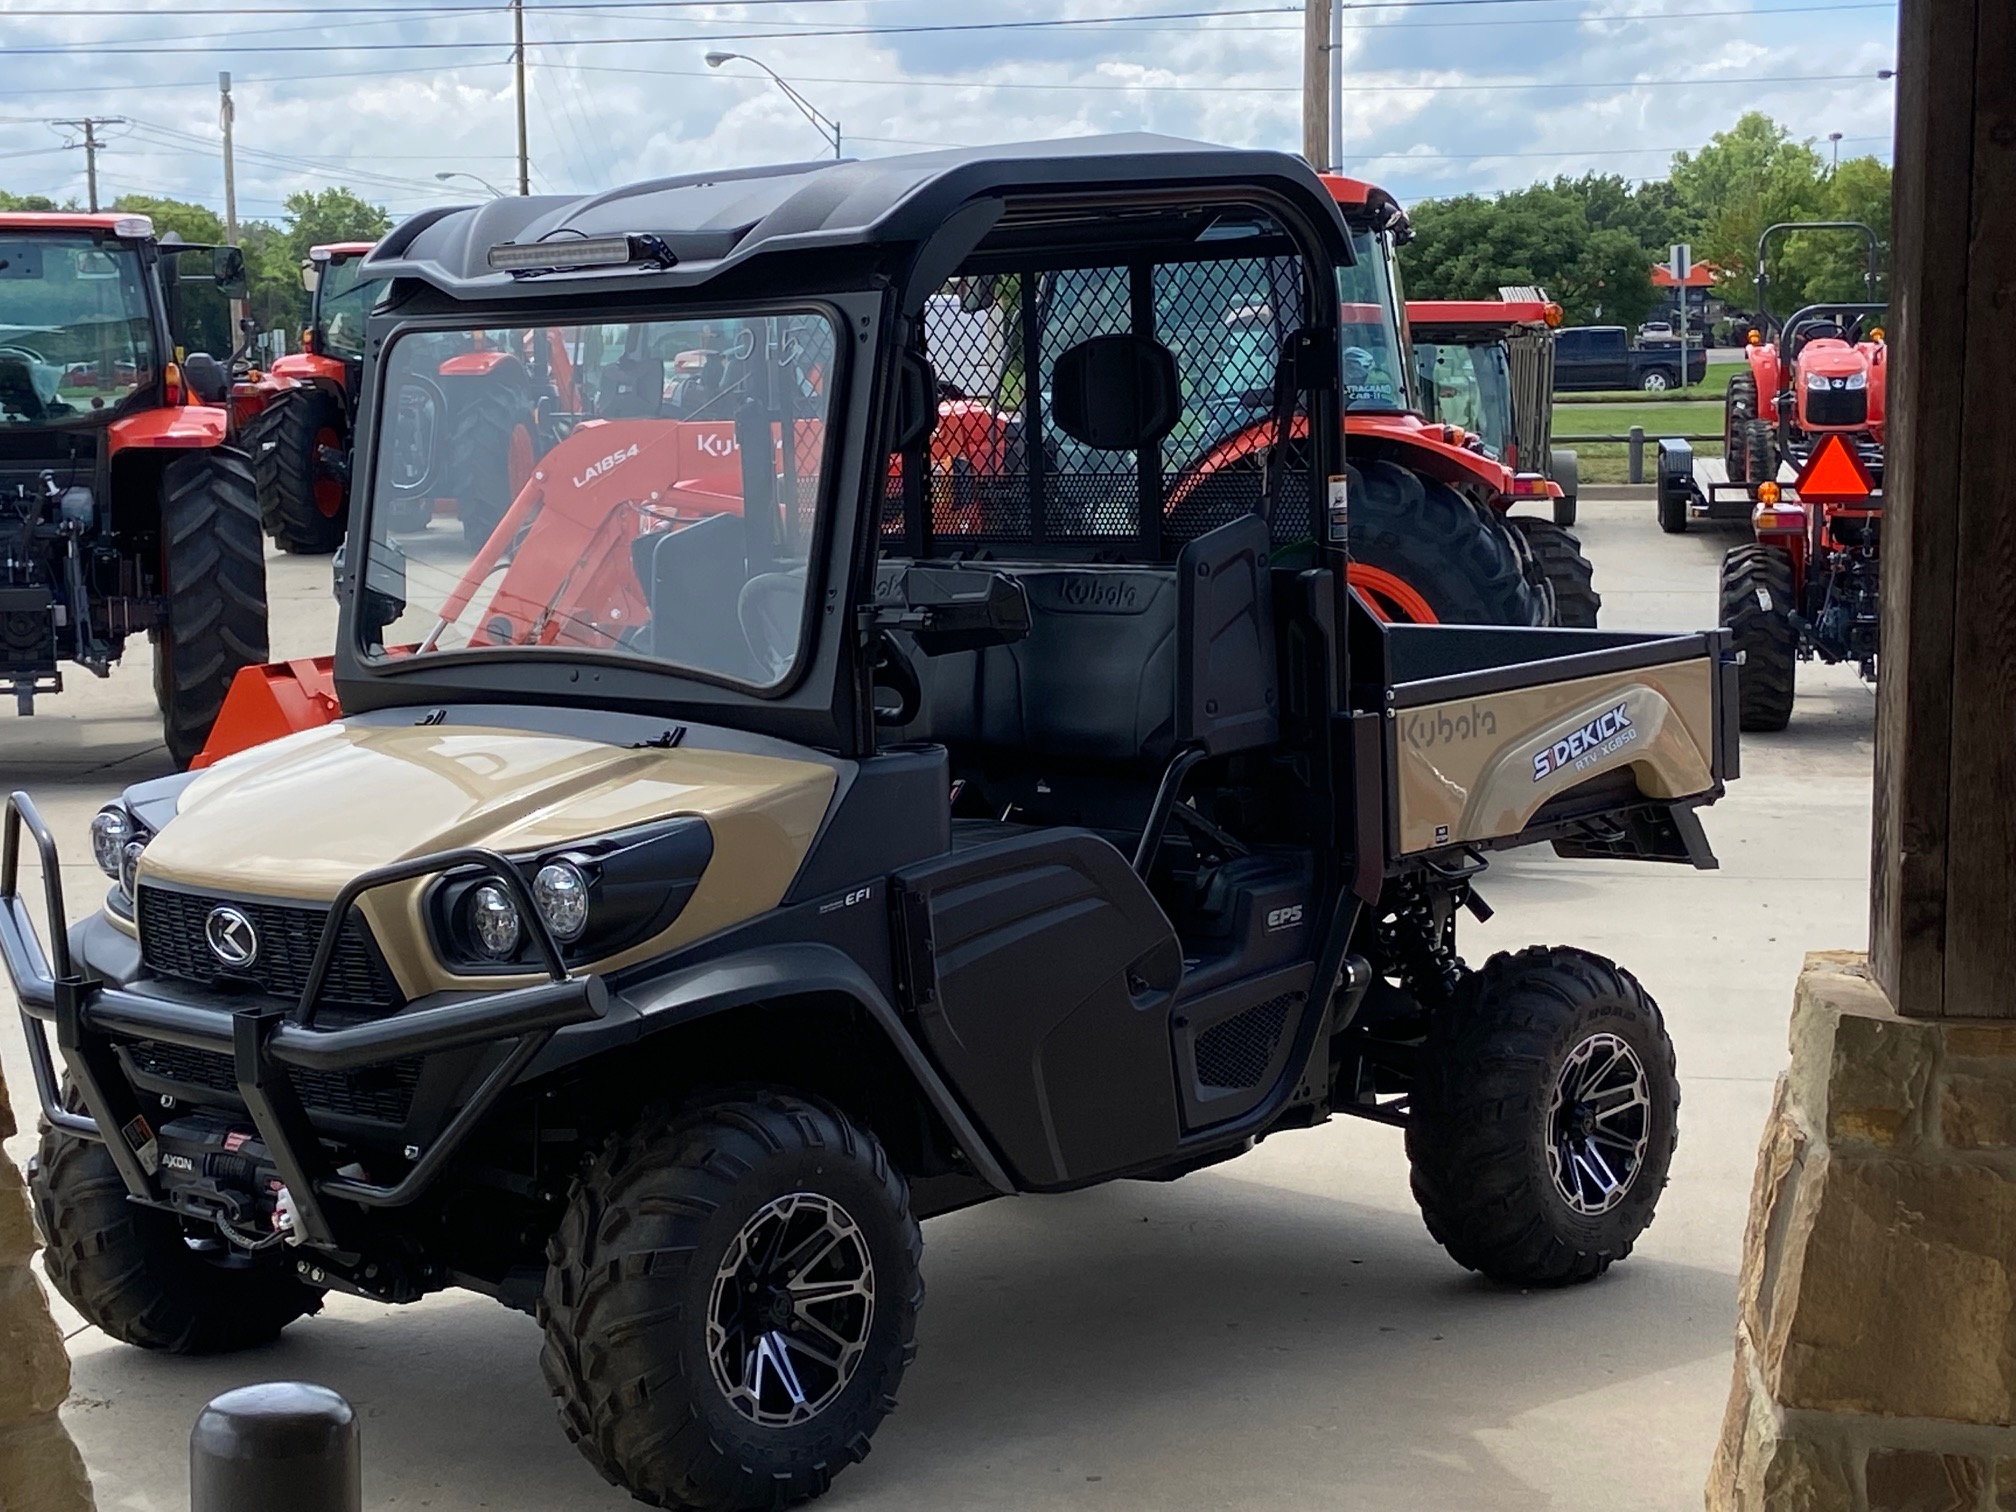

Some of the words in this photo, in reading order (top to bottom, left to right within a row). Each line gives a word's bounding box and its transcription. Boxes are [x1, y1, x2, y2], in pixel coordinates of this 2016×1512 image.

[573, 443, 640, 488] LA1854
[1058, 578, 1136, 606] Kubota
[1400, 703, 1497, 749] Kubota
[1534, 702, 1632, 781] SIDEKICK
[1576, 754, 1599, 773] RTV
[845, 887, 870, 906] EFI
[1268, 904, 1303, 927] EPS
[162, 1153, 192, 1171] AXON
